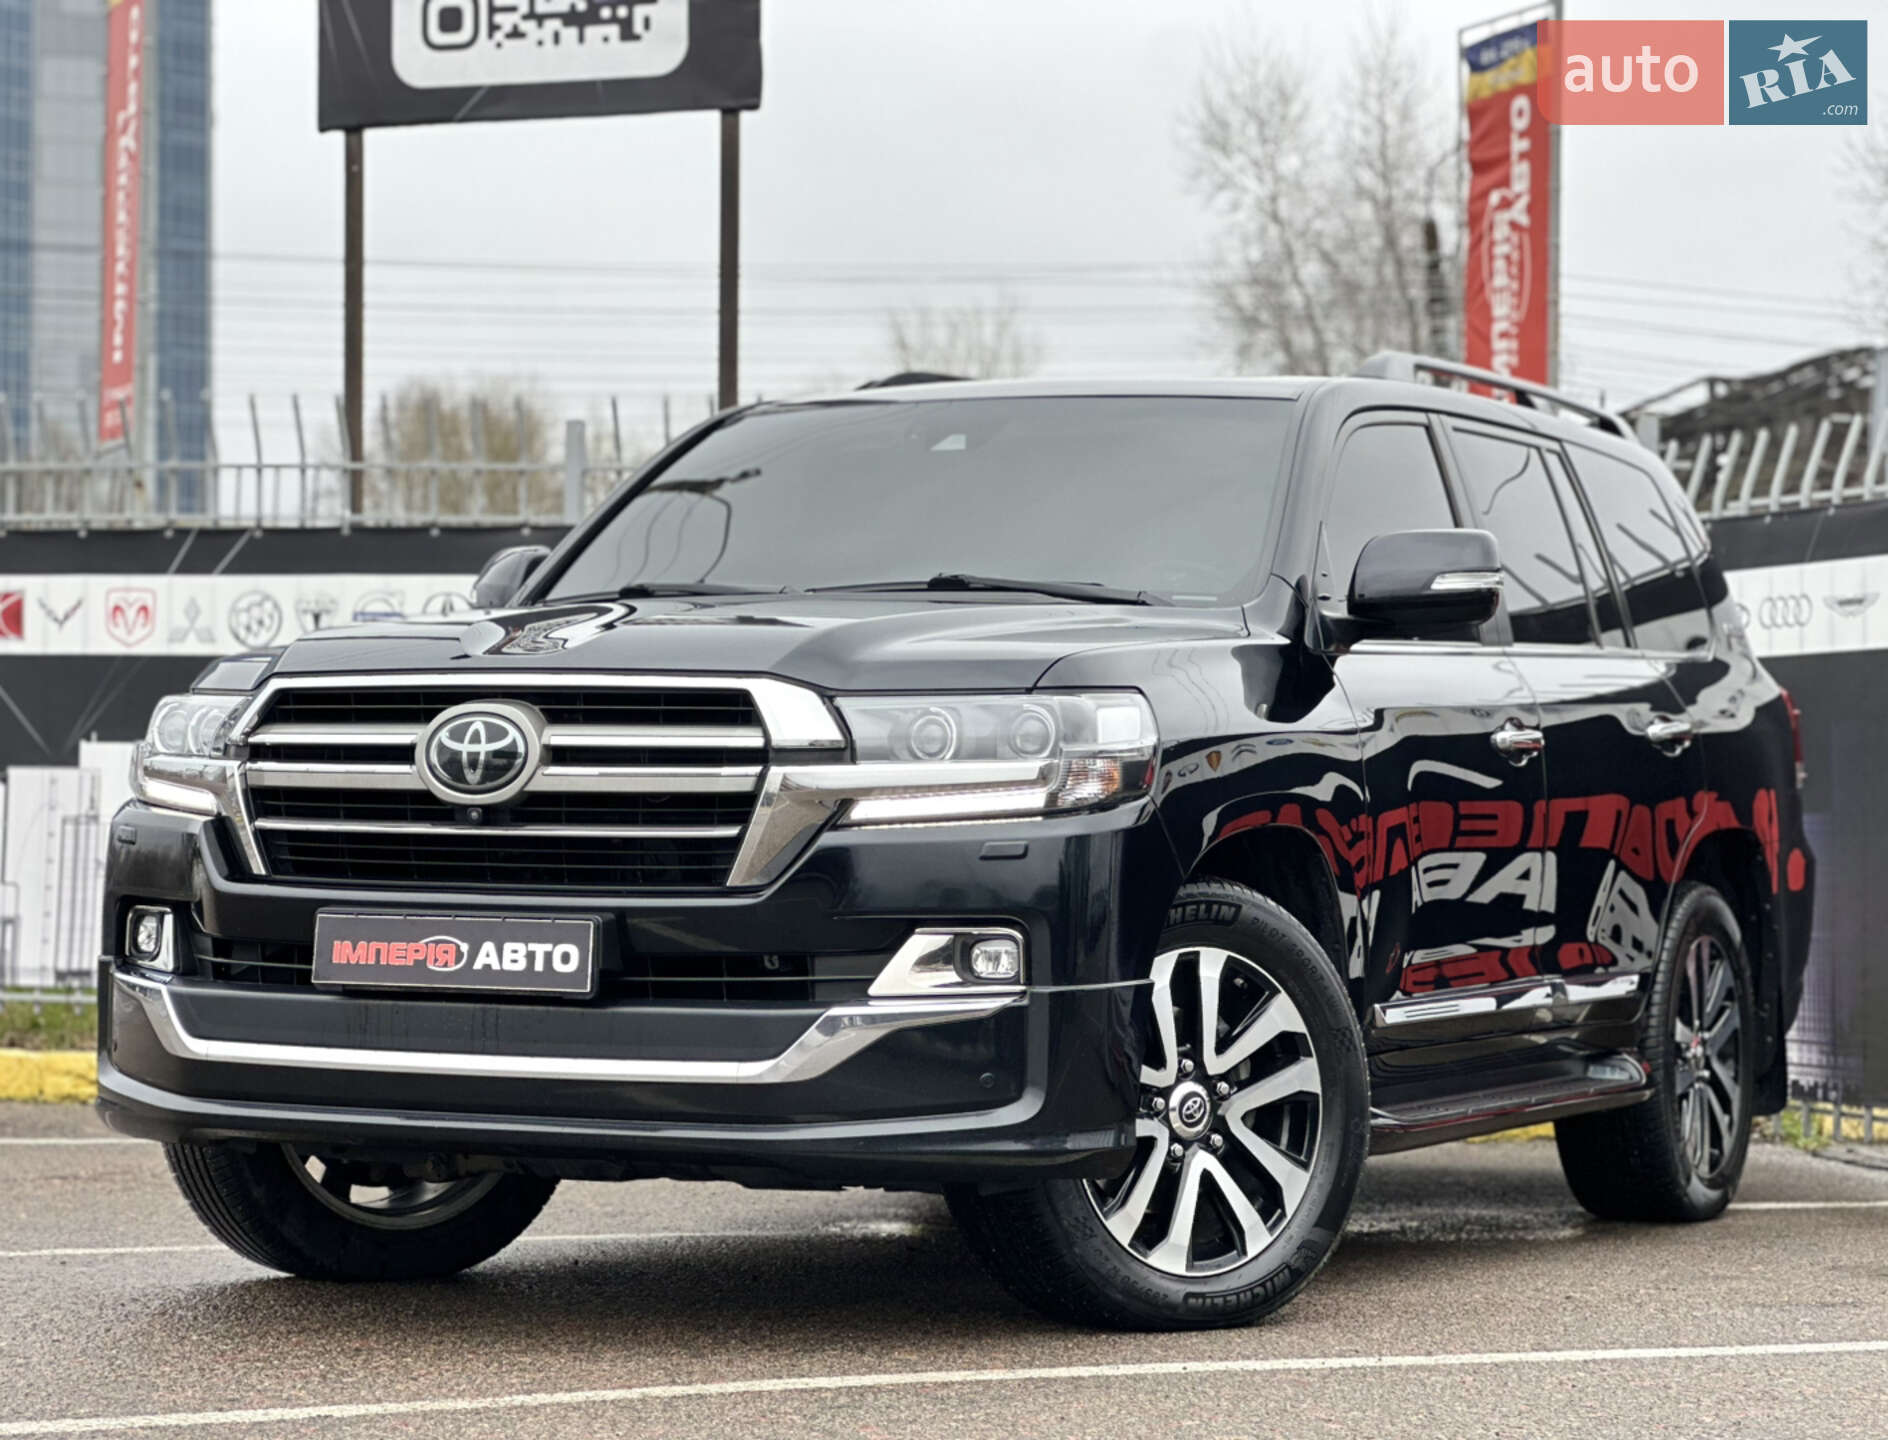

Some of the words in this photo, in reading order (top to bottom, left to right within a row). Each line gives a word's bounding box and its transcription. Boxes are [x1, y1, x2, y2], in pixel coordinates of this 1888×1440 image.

[1509, 94, 1532, 228] АВТО
[1167, 902, 1238, 923] HELIN
[332, 939, 457, 968] ІМПЕРІЯ
[472, 941, 580, 973] АВТО
